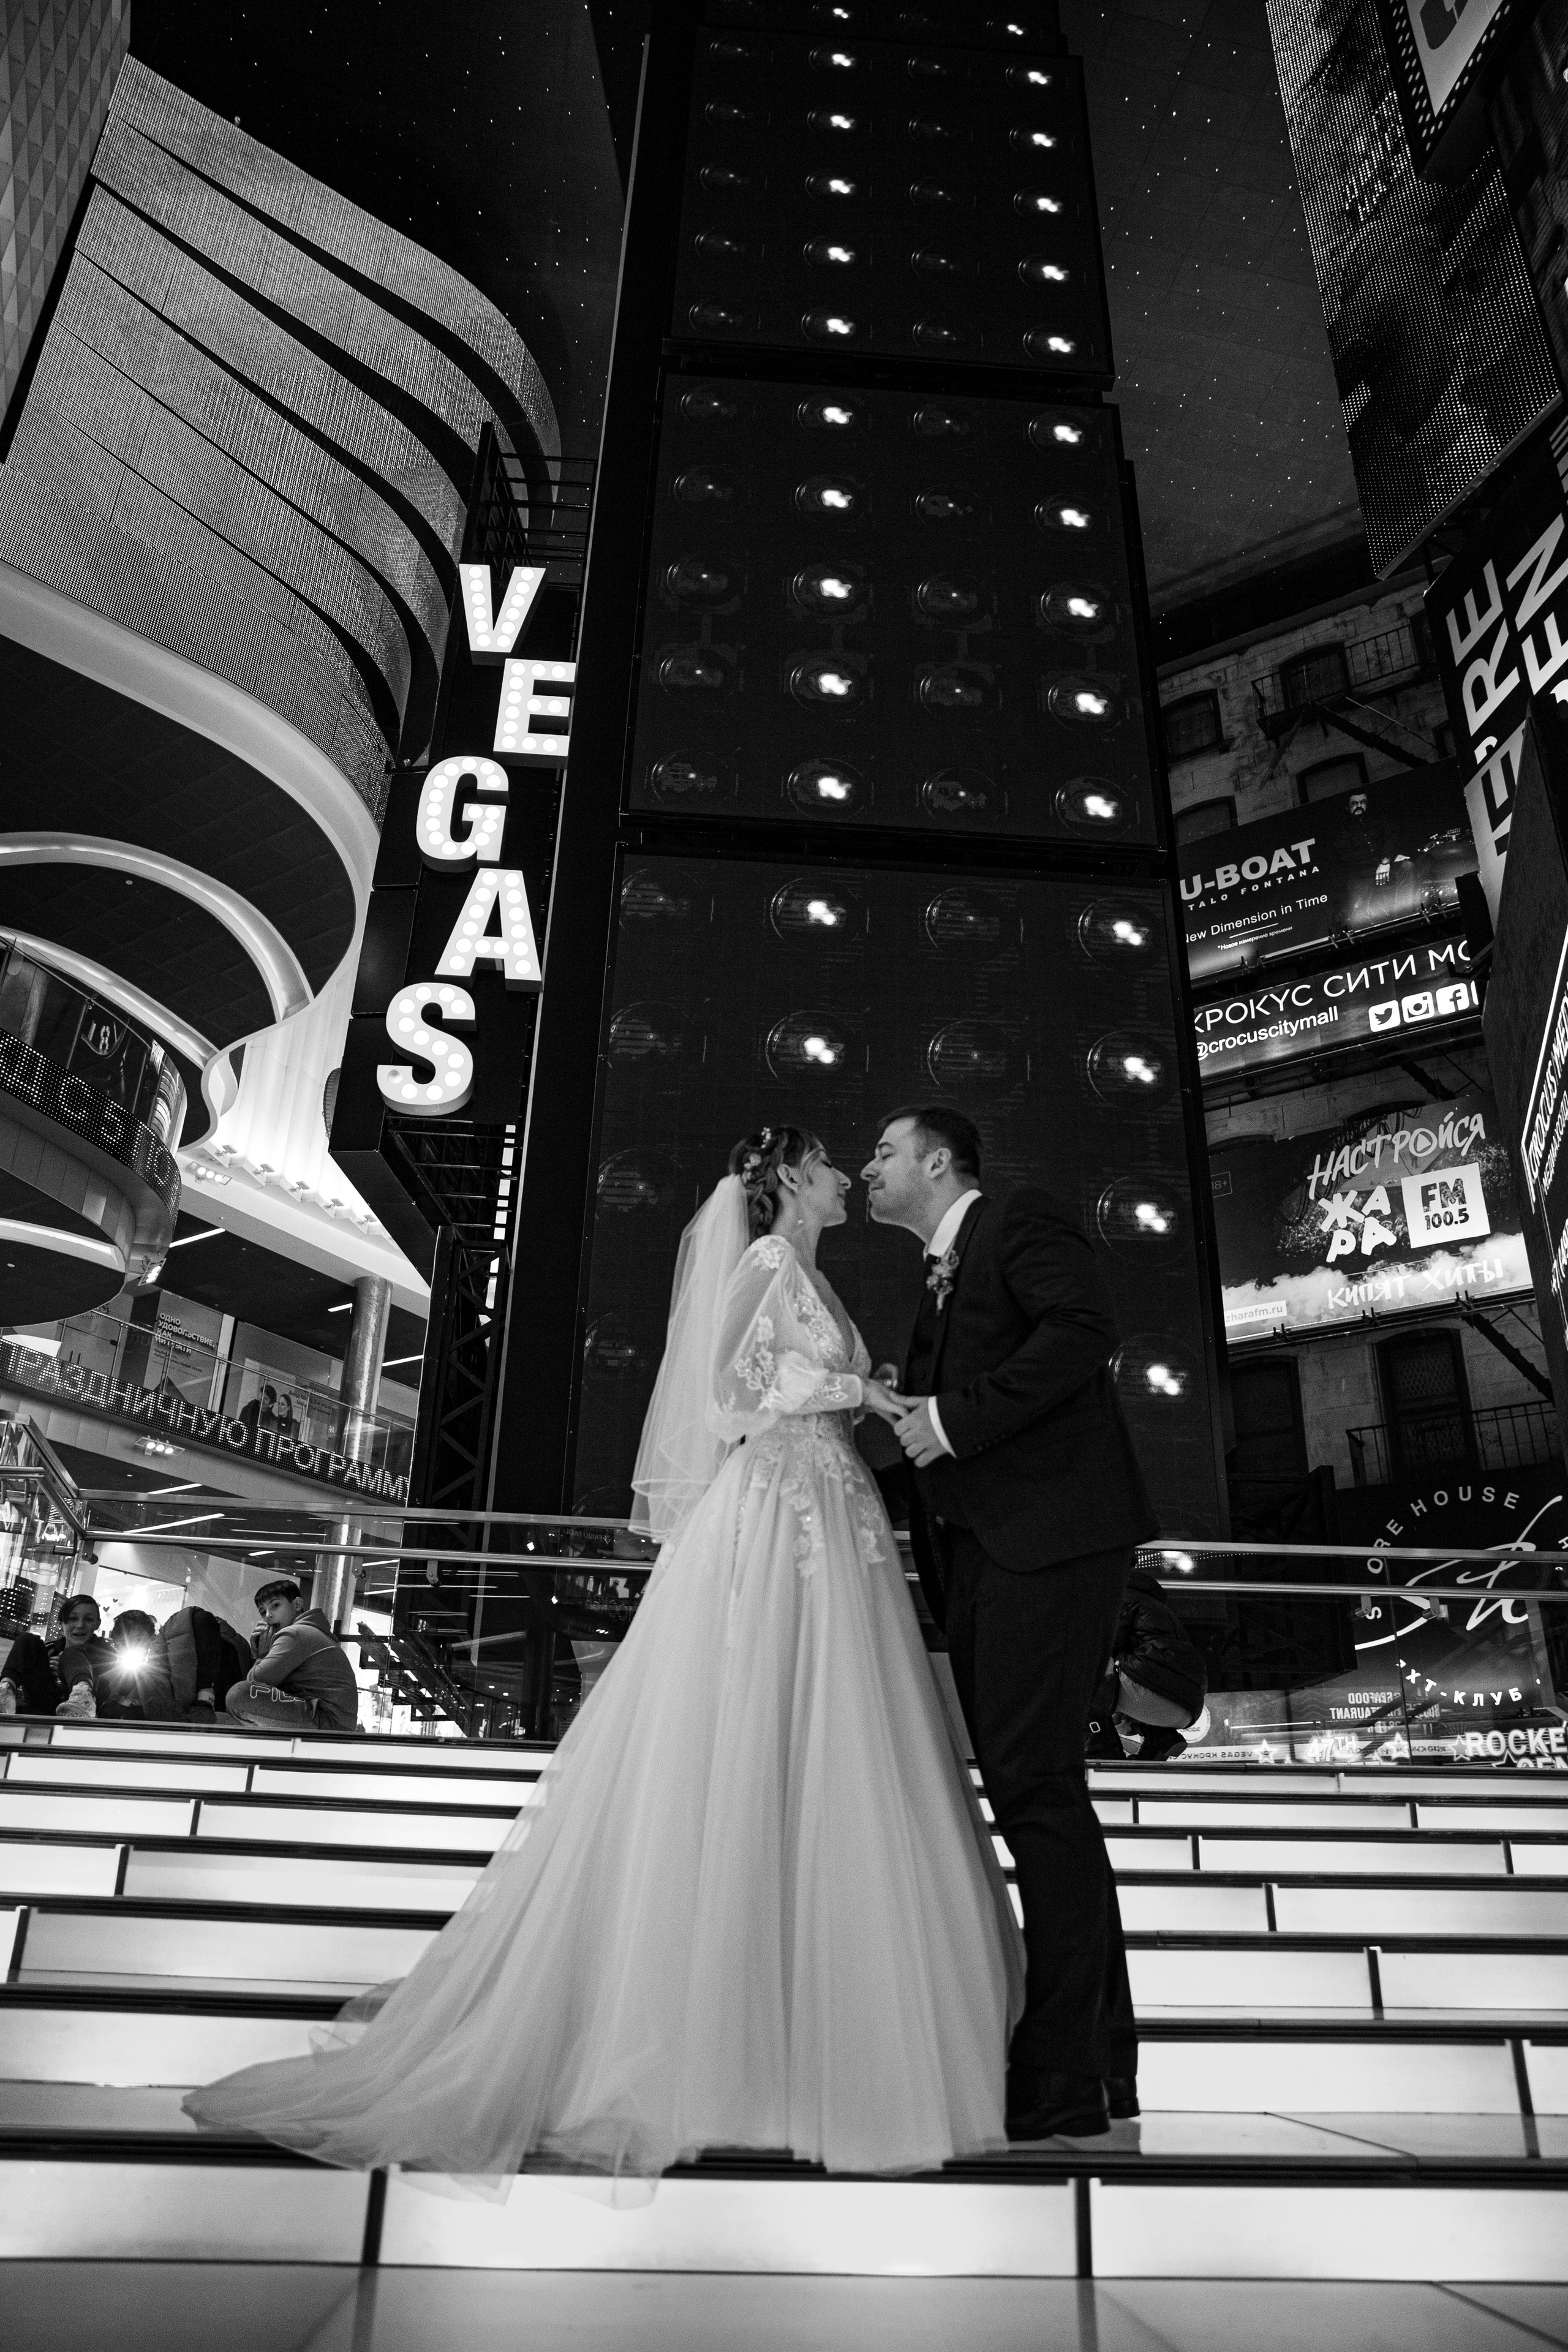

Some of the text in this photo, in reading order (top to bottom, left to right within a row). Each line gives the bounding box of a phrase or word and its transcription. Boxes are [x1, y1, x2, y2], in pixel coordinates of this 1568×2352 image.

[377, 564, 576, 1114] VEGAS
[1180, 838, 1316, 900] U-BOAT
[1241, 866, 1319, 894] FONTANA
[1211, 909, 1276, 936] Dimension
[1281, 905, 1292, 914] in
[1295, 895, 1328, 910] Time
[1269, 926, 1292, 937] времени
[1324, 954, 1416, 997] СИТИ
[1197, 1005, 1338, 1061] @crocuscitymall
[1528, 1060, 1557, 1181] CROCUS
[1307, 1112, 1486, 1200] НАСТРОЙСЯ
[1421, 1178, 1467, 1213] FM
[1425, 1207, 1470, 1231] 100.5
[1326, 1259, 1504, 1310] КИПЯТ ХИТЫ
[157, 1328, 172, 1338] КАК
[160, 1313, 181, 1325] ОДНО
[1226, 1306, 1283, 1323] zharafm.ru
[255, 1428, 409, 1502] ПРОГРАММ
[1410, 1486, 1520, 1517] HOUSE
[250, 1684, 306, 1703] FIL
